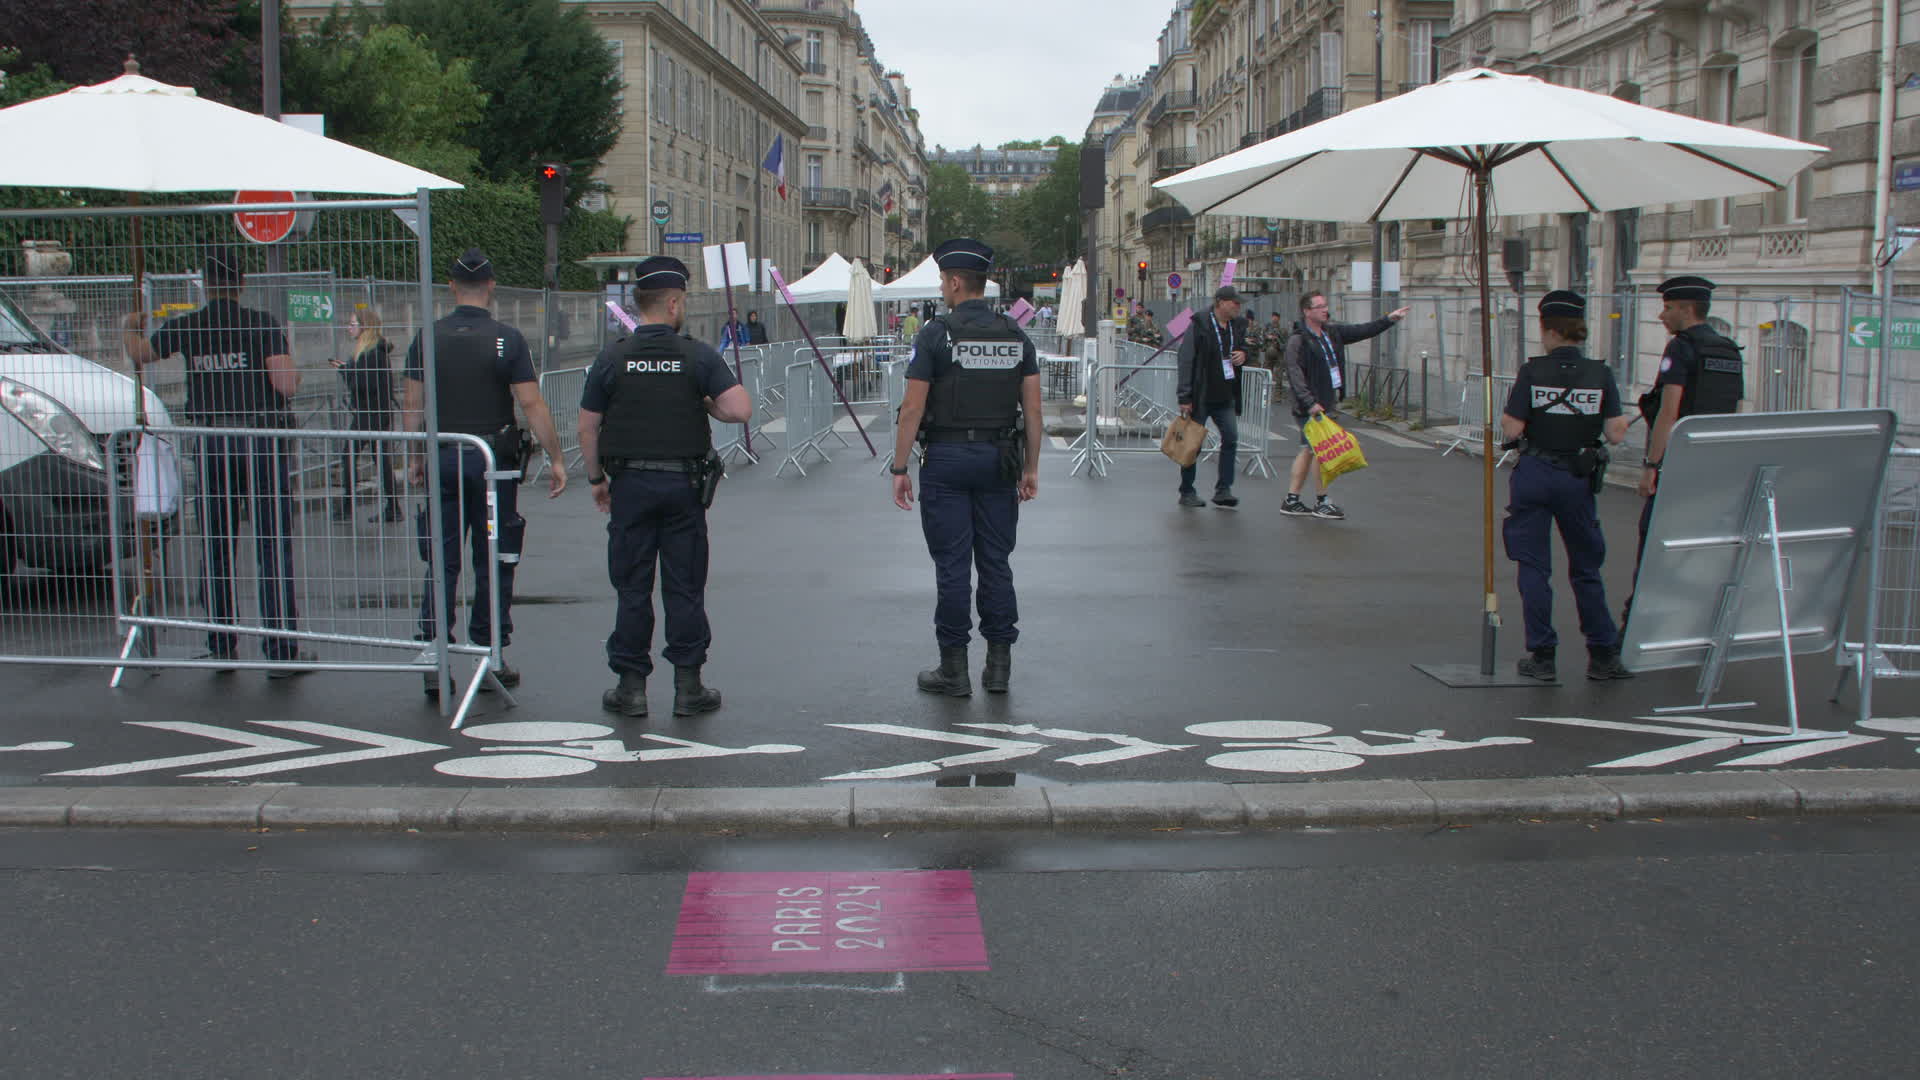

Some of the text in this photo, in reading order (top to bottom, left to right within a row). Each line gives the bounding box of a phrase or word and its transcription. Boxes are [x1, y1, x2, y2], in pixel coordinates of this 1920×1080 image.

[957, 345, 1019, 357] POLICE
[192, 352, 248, 371] POLICE
[626, 360, 681, 372] POLICE
[1535, 390, 1599, 403] POICE
[835, 886, 884, 949] 2024
